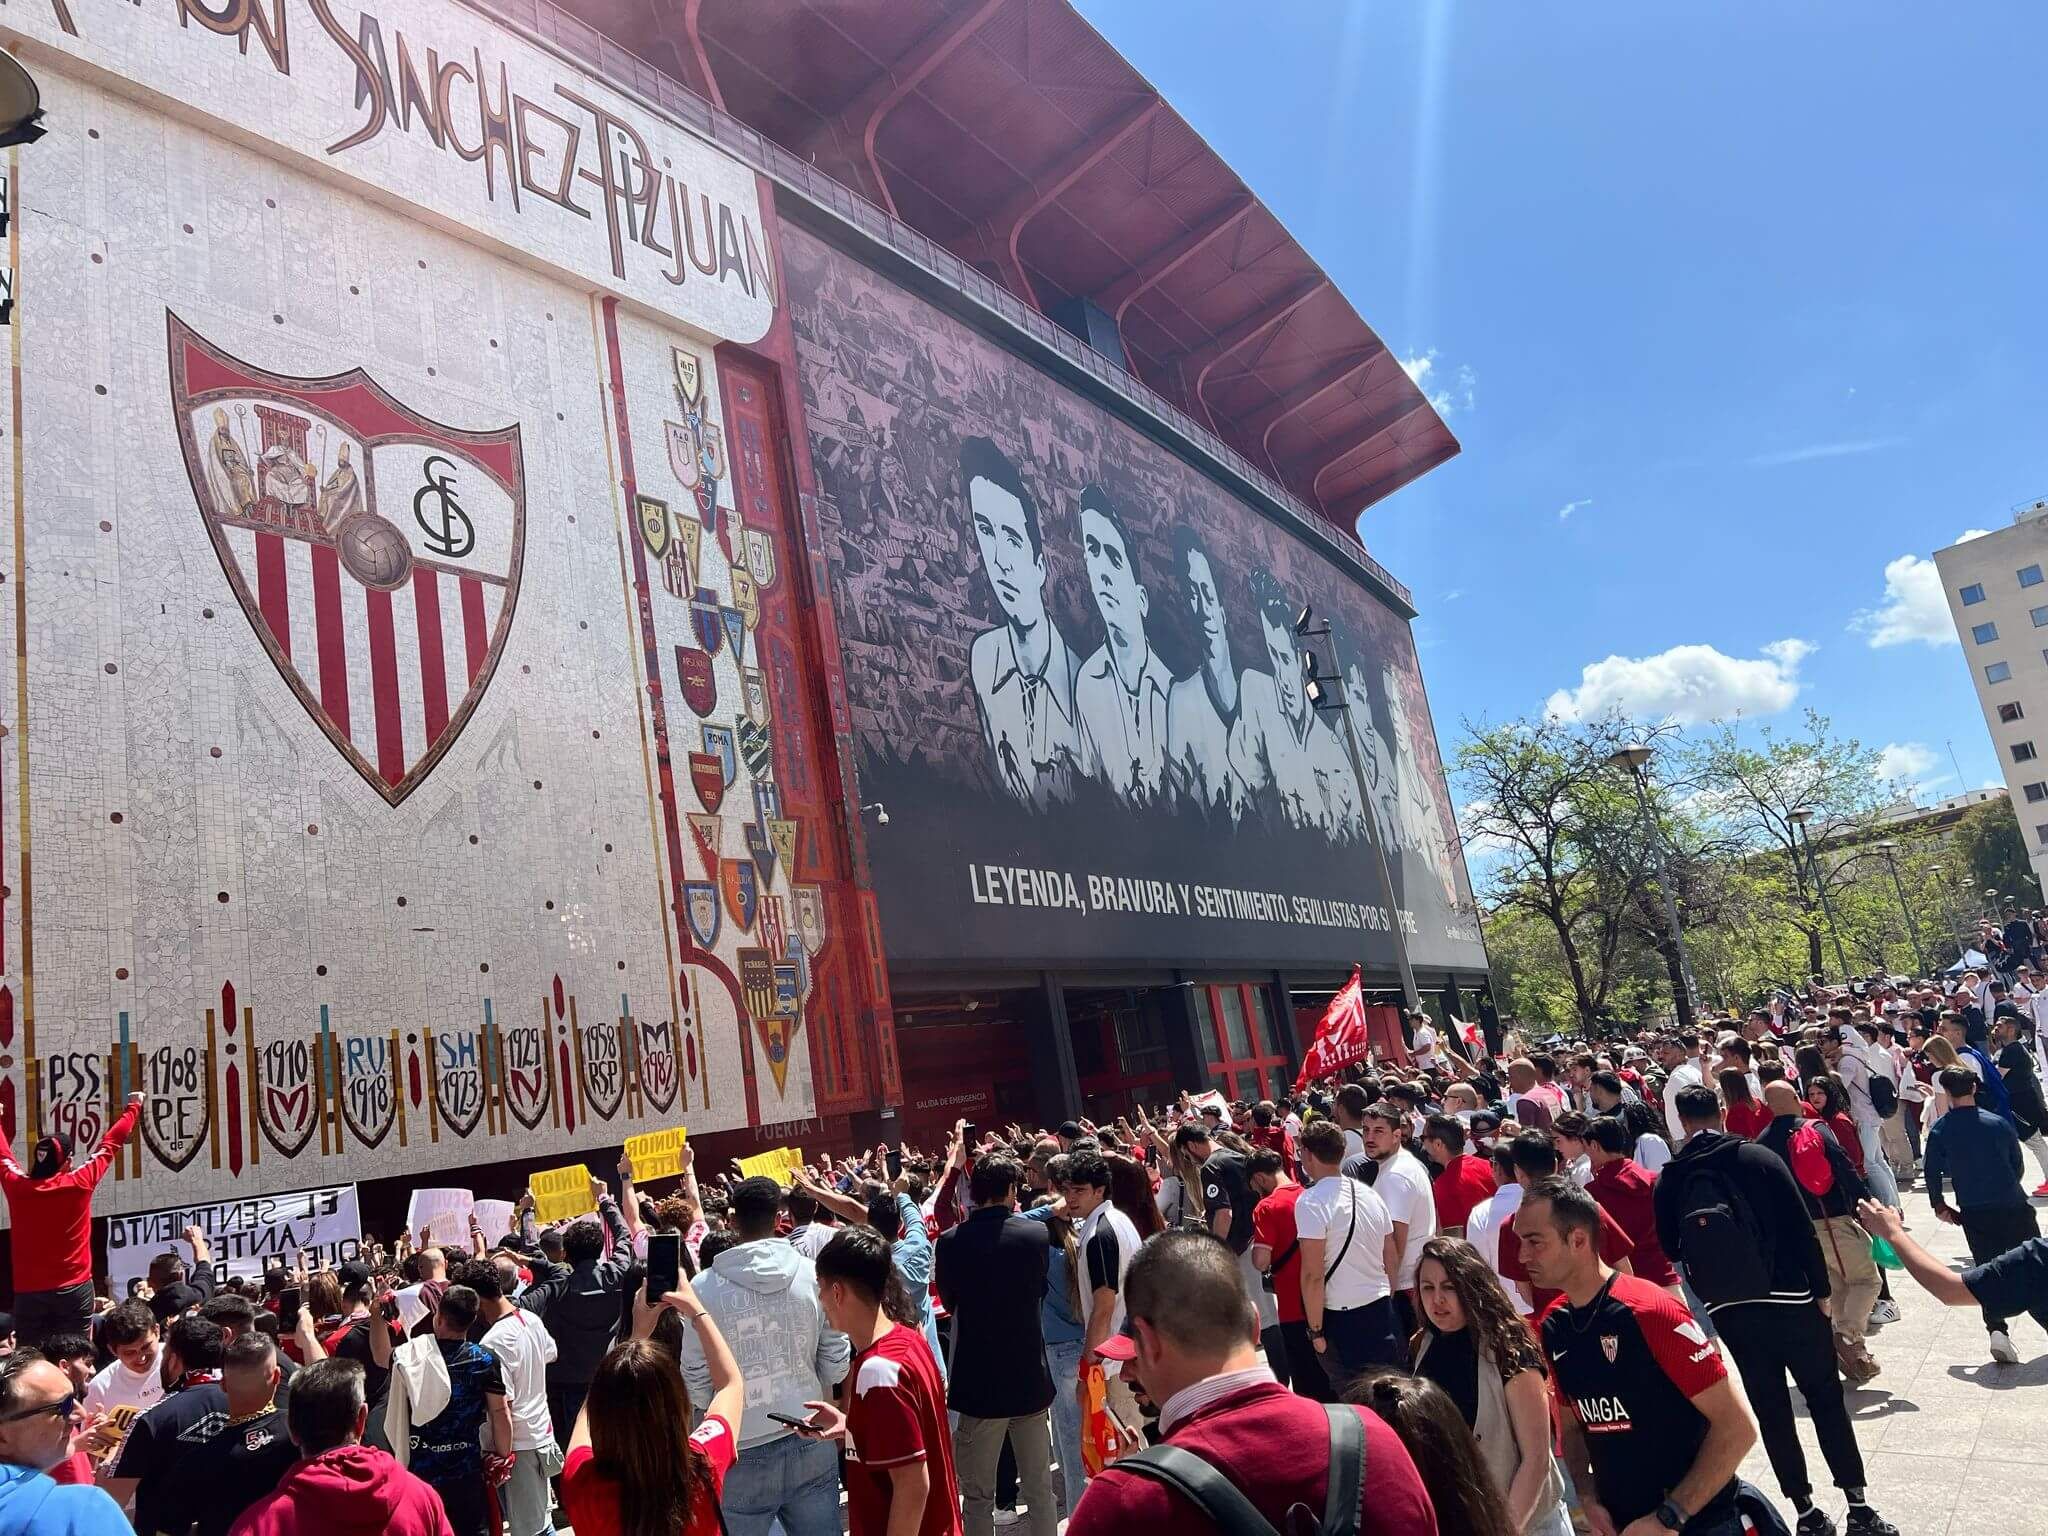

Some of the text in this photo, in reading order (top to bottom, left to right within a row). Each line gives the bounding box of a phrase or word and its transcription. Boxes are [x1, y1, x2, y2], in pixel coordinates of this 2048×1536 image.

[707, 733, 728, 746] ROMA
[970, 864, 1086, 917] LEYENDA,
[1088, 875, 1179, 914] BRAVURA
[1178, 884, 1191, 915] Y
[1195, 885, 1293, 923] SENTIMIENTO.
[1292, 896, 1360, 929] SEVILLISTAS
[1359, 904, 1381, 930] POR
[1380, 906, 1418, 933] SIPRE
[264, 1040, 307, 1087] 1910
[507, 1028, 541, 1068] 1929
[584, 1023, 616, 1060] 1958
[149, 1046, 197, 1095] 1908
[644, 1051, 673, 1095] 1982
[348, 1075, 388, 1128] 1918
[441, 1070, 477, 1118] 1923
[50, 1103, 100, 1153] 1905
[755, 1119, 812, 1141] PUERTA
[1577, 1396, 1630, 1423] NAGA
